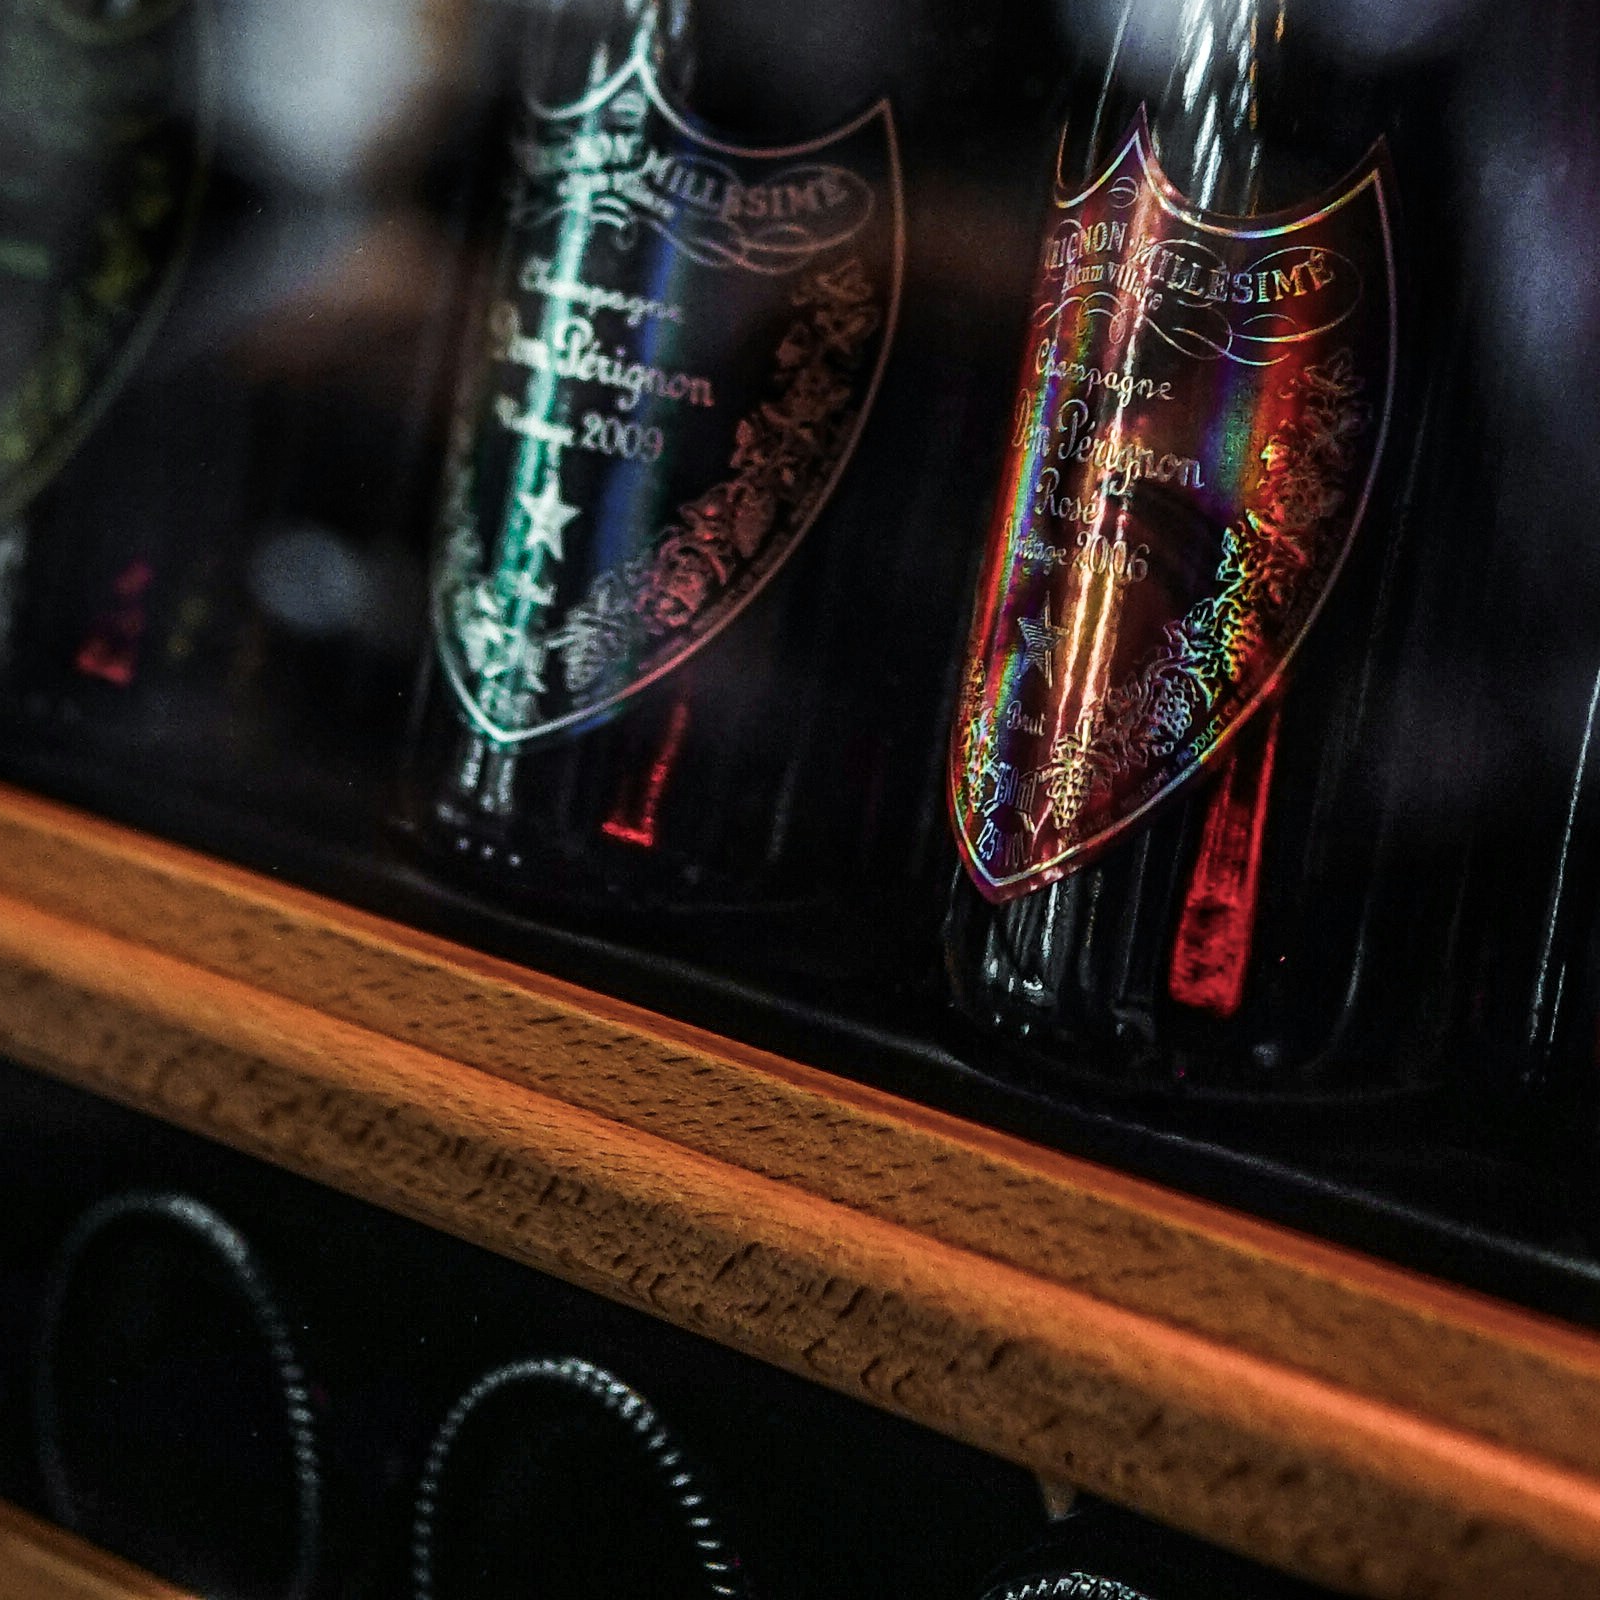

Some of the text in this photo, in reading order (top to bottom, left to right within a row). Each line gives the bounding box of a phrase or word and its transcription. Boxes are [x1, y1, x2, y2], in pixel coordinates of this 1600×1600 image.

[582, 411, 664, 463] 2009
[1056, 399, 1206, 496] Pérignon
[1034, 466, 1101, 525] Rosé
[1075, 530, 1150, 583] 2006
[1006, 700, 1047, 737] Brut
